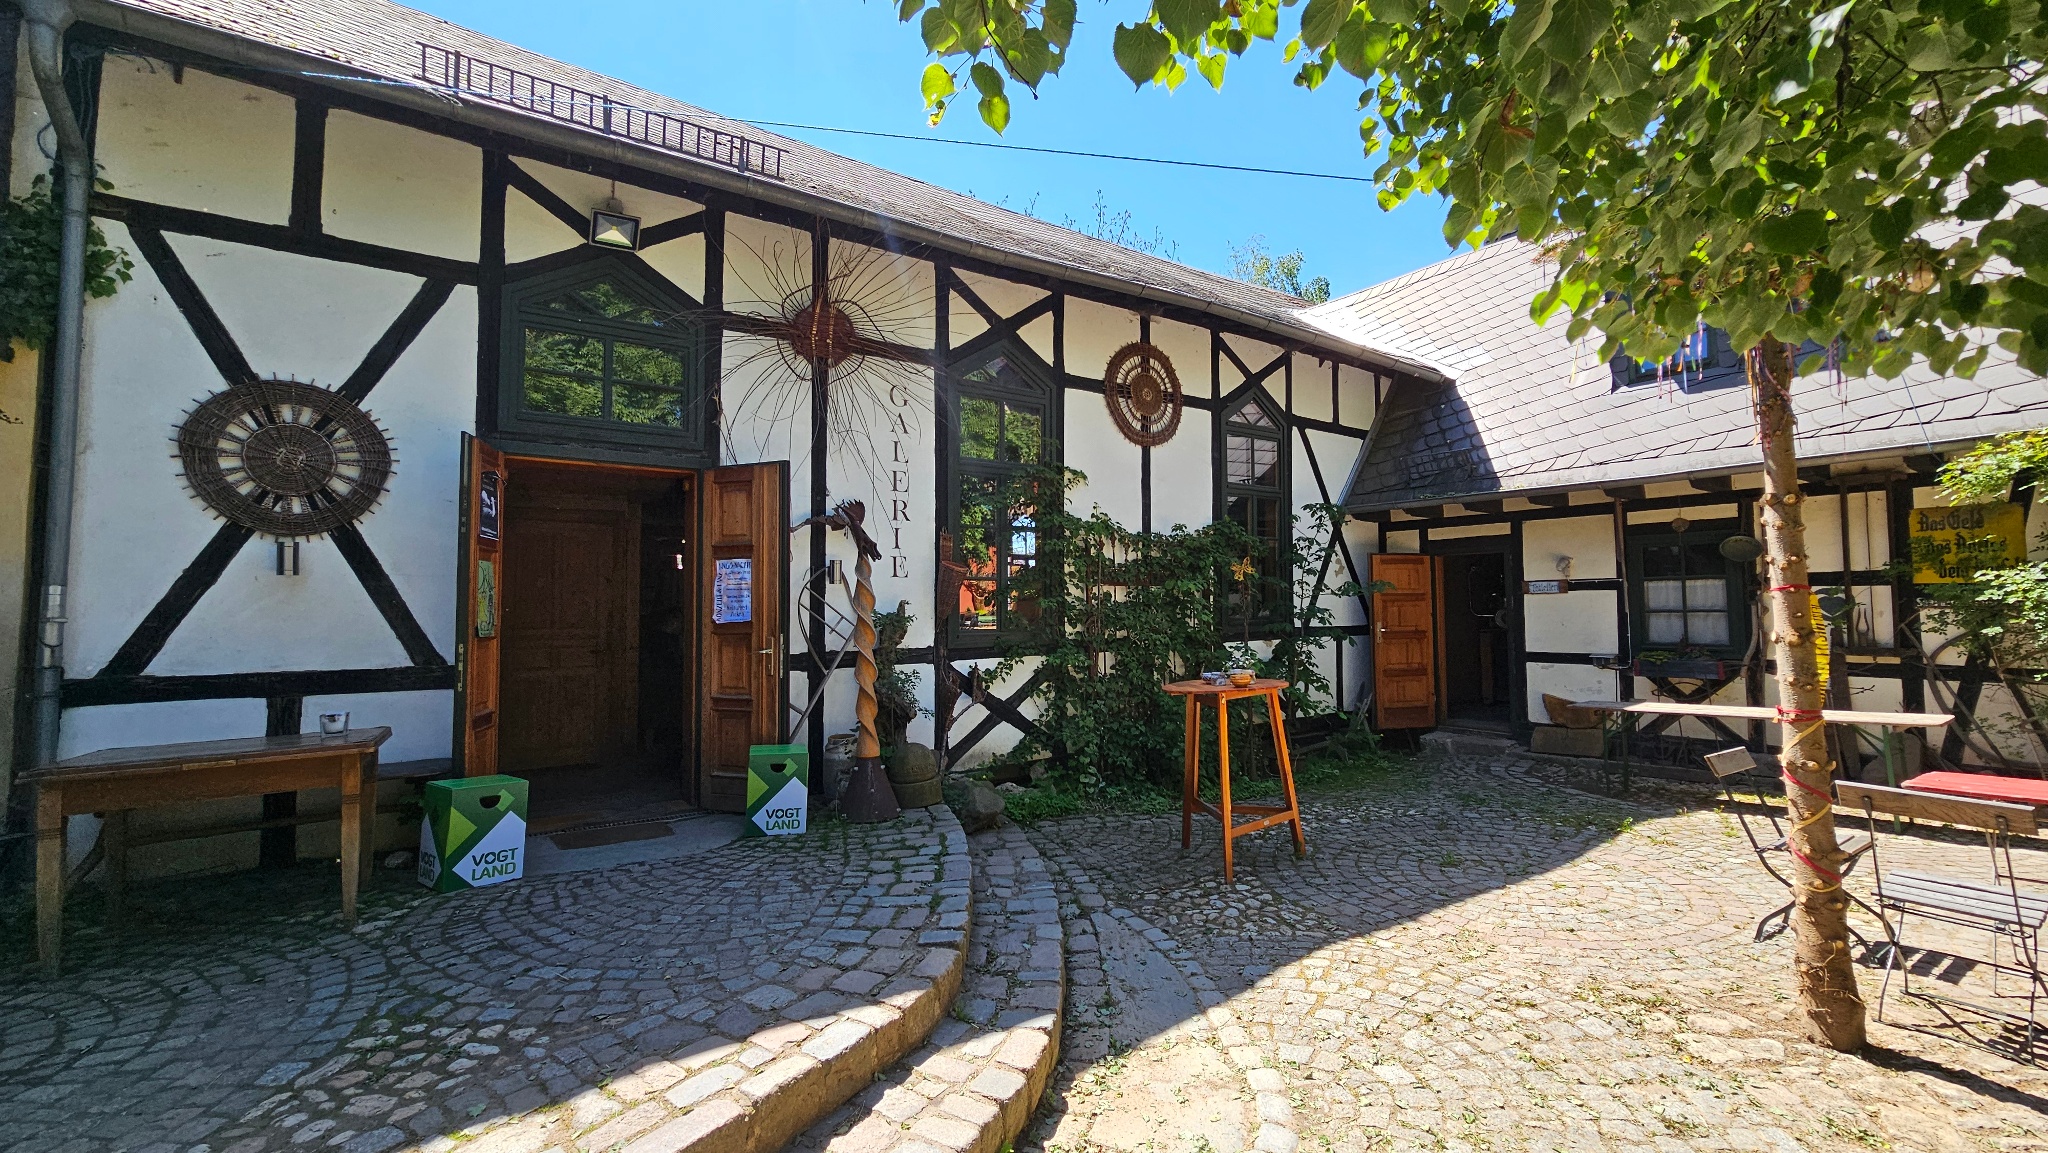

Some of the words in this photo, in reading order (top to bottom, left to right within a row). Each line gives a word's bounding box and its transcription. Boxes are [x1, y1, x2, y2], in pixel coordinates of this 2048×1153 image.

[889, 385, 910, 578] GALERIE
[765, 807, 802, 819] VOGT
[765, 819, 800, 830] LAND
[471, 847, 518, 867] VOGT
[471, 861, 516, 881] LAND
